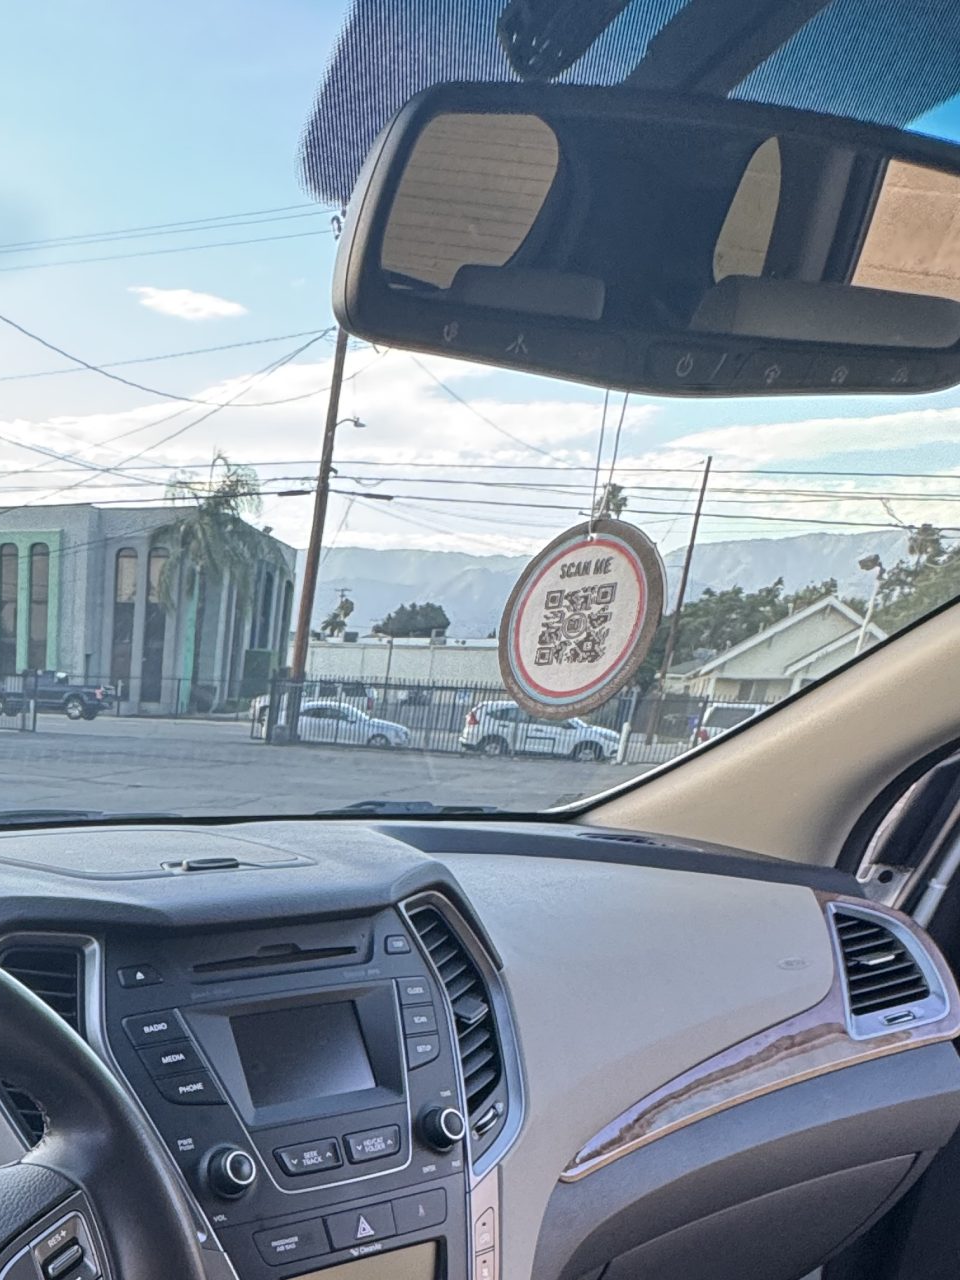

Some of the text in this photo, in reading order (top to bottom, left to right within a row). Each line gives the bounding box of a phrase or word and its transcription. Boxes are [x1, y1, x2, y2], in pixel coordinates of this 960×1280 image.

[560, 556, 614, 579] SCAN ME
[143, 1022, 167, 1034] RADIO
[161, 1053, 185, 1064] MEDIA
[178, 1082, 204, 1094] PHONE
[213, 1214, 227, 1223] VOL
